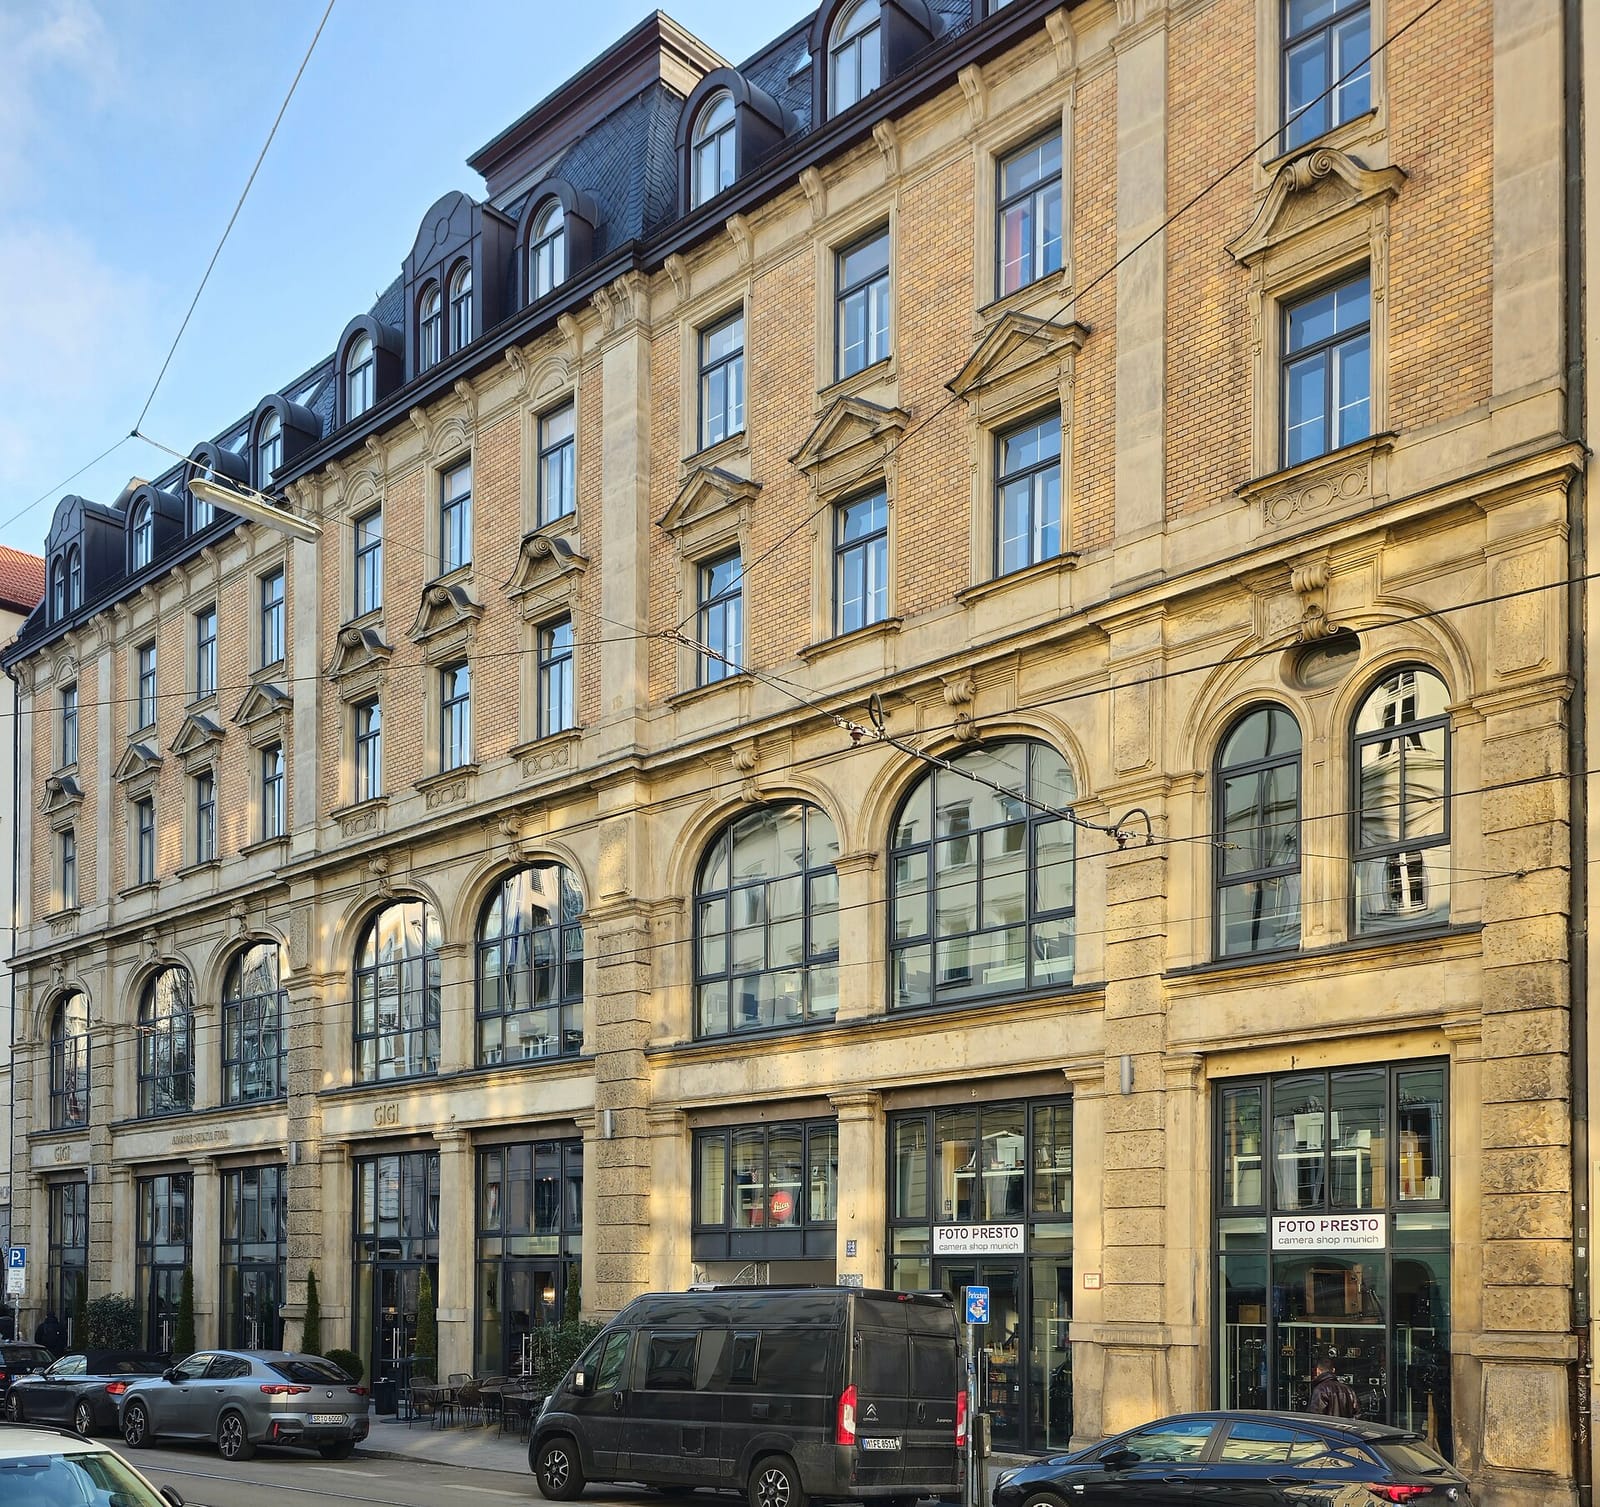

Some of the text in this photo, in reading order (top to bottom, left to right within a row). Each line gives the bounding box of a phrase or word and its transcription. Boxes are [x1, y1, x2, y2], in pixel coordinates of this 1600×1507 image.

[374, 1103, 399, 1126] GIGI
[55, 1145, 70, 1162] GIGI
[773, 1201, 790, 1213] Leica
[1278, 1219, 1379, 1232] FOTO PRESTO
[939, 1227, 1019, 1239] FOTO PRESTO
[1278, 1235, 1379, 1245] camera shop munich
[939, 1242, 1019, 1251] camera shop munich
[11, 1250, 21, 1266] P
